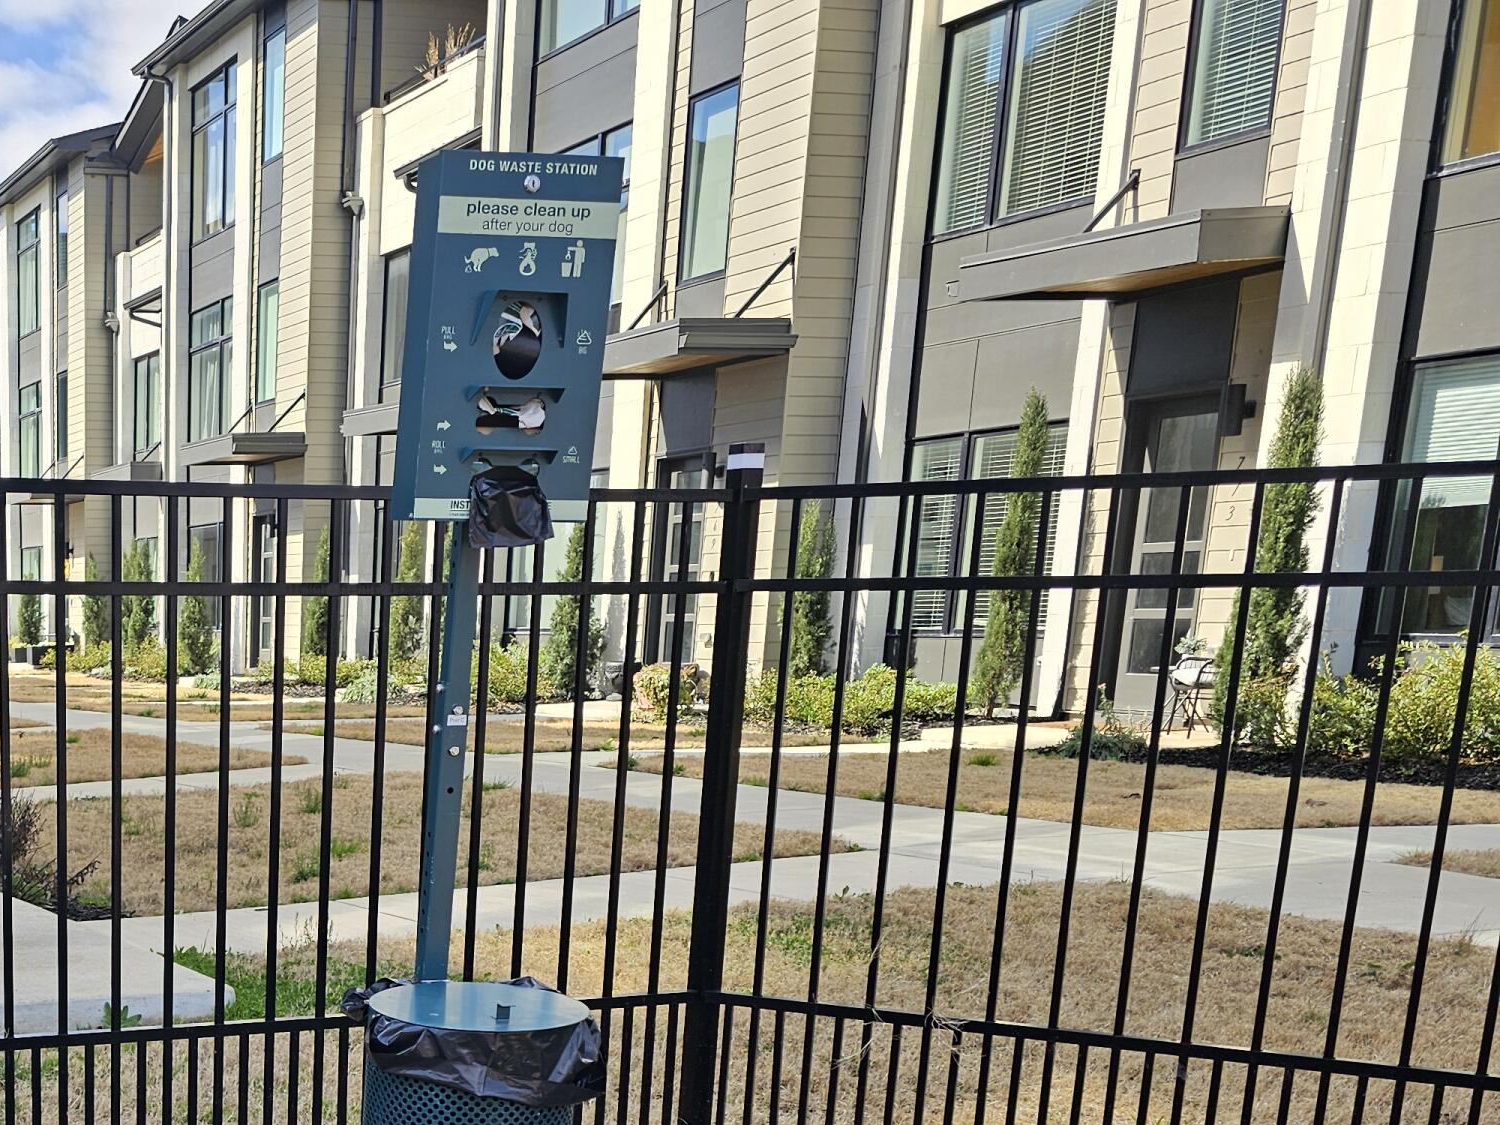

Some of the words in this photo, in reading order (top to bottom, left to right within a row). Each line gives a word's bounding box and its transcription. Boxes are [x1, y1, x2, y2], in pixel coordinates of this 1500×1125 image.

[469, 159, 495, 171] DOG
[499, 161, 542, 173] WASTE
[546, 162, 598, 176] STATION
[467, 200, 519, 217] please
[523, 202, 566, 217] clean
[571, 207, 591, 221] up
[482, 218, 513, 231] after
[515, 221, 545, 234] your
[548, 221, 574, 236] dog
[441, 325, 456, 335] PULL
[431, 440, 446, 449] ROLL
[563, 455, 580, 464] SMALL
